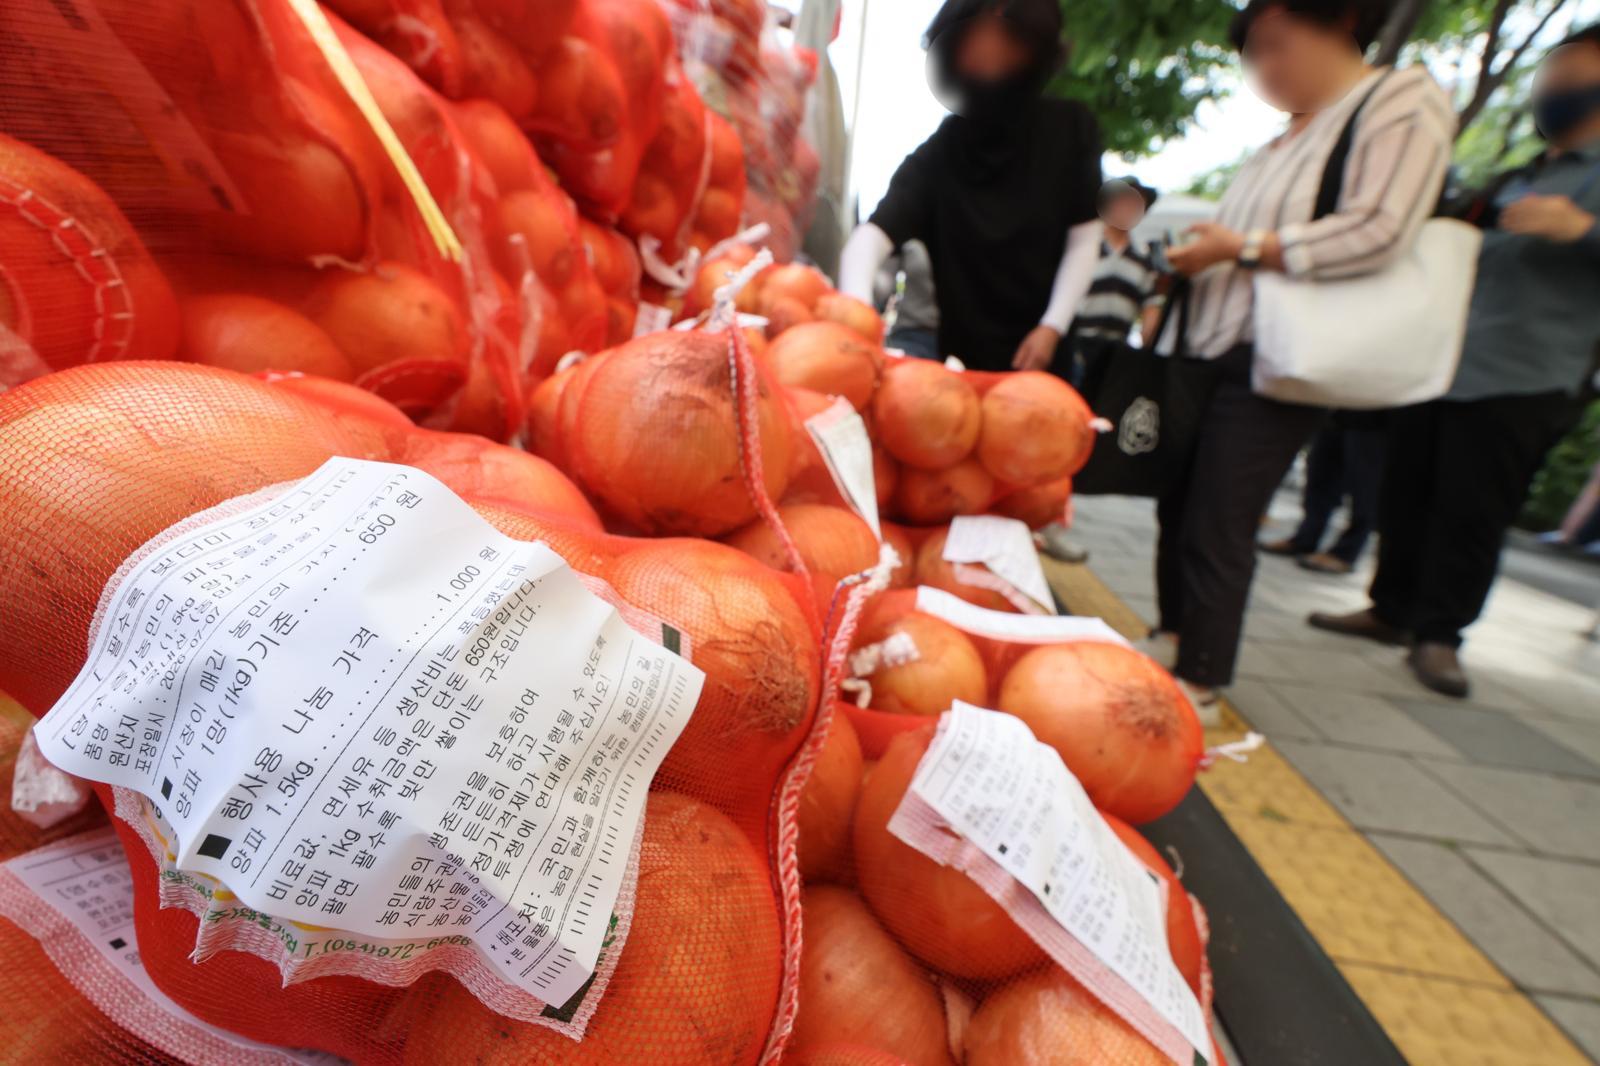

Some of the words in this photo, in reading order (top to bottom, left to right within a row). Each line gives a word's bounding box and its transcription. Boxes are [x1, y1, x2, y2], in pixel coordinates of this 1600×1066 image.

[107, 587, 145, 657] 팔수록
[151, 532, 231, 576] 빚더미
[173, 702, 207, 768] 시장이
[200, 649, 226, 693] 매긴
[228, 582, 290, 639] 농민의
[176, 769, 202, 818] 양파
[396, 490, 423, 509] 원
[83, 723, 109, 760] 품명
[109, 714, 139, 766] 원산지
[134, 712, 166, 775] 포장일시
[221, 747, 283, 820] 행사용
[282, 686, 334, 734] 나눔
[332, 627, 379, 675] 가격
[231, 827, 266, 874] 양파
[479, 546, 500, 562] 원
[266, 835, 327, 900] 비료값,
[322, 757, 375, 818] 면세유
[373, 726, 397, 747] 등
[396, 644, 460, 717] 생산비는
[457, 565, 526, 635] 폭등했는데
[295, 870, 332, 907] 양파
[328, 829, 361, 857] 1kg
[357, 719, 435, 819] 수취금액은
[432, 672, 468, 710] 단돈
[465, 579, 542, 667] 650원입니다.
[321, 879, 359, 915] 팔면
[351, 810, 402, 869] 팔수록
[397, 760, 437, 801] 빚만
[435, 694, 484, 749] 쌓이는
[479, 605, 541, 683] 구조입니다.
[376, 857, 434, 926] 농민들의
[428, 771, 489, 850] 생존권을
[485, 688, 539, 763] 보호하여
[427, 882, 471, 927] 농산물
[463, 772, 540, 884] 공정가격제가
[538, 709, 574, 764] 시행될
[572, 687, 585, 702] 수
[583, 635, 607, 680] 있도록
[538, 816, 579, 876] 국민과
[573, 734, 618, 804] 함께하는
[617, 676, 645, 725] 농민의
[636, 656, 651, 671] 길
[403, 853, 465, 927] 식량주권을
[462, 781, 510, 842] 든든히
[506, 734, 538, 771] 하고
[451, 888, 496, 926] 농민들의
[493, 819, 537, 880] 투쟁에
[535, 754, 571, 809] 연대해
[522, 905, 555, 949] 물품은
[550, 865, 574, 896] 농업
[570, 814, 594, 858] 현실을
[589, 767, 612, 807] 알리기
[610, 737, 629, 761] 위한
